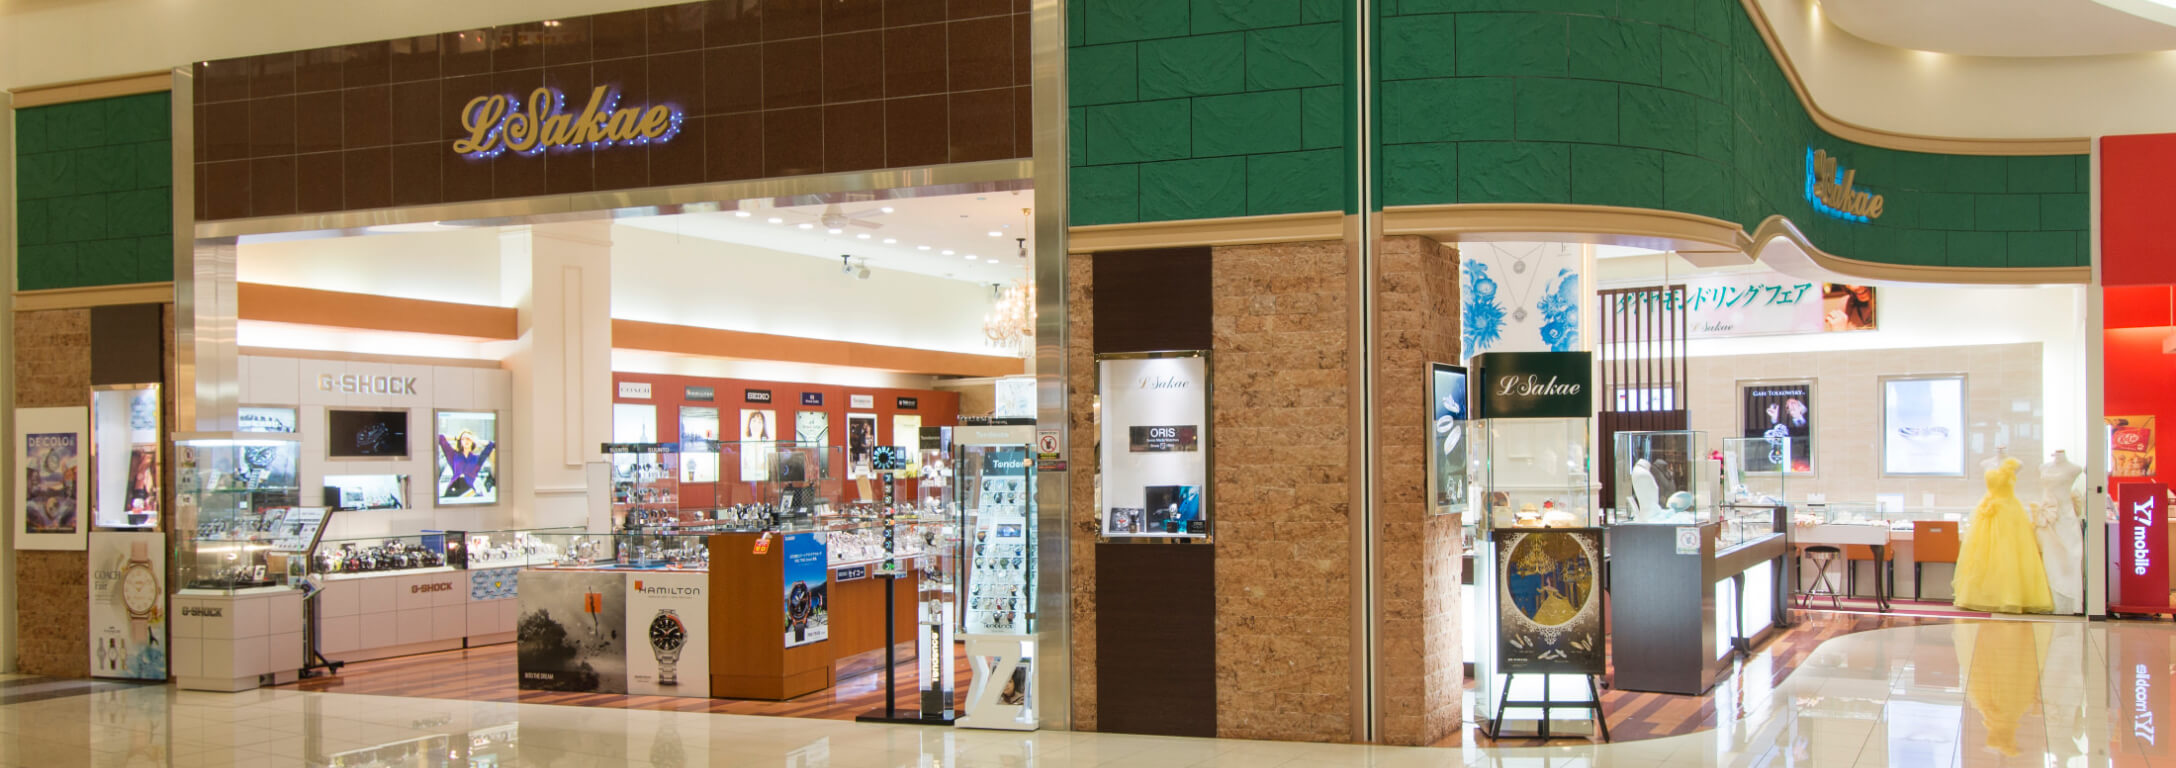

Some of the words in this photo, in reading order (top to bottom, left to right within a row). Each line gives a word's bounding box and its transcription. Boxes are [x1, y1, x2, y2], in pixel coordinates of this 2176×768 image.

[503, 84, 671, 151] Sakae
[318, 374, 417, 395] G-SHOCK
[1151, 376, 1190, 389] Sakae
[1517, 374, 1581, 396] Sakae
[747, 391, 770, 401] SEIKO
[1150, 428, 1176, 438] ORIS
[2134, 526, 2150, 575] mobile
[411, 582, 453, 594] G-SHOCK
[638, 586, 701, 596] HAMILTON
[181, 606, 223, 617] G-SHOCK
